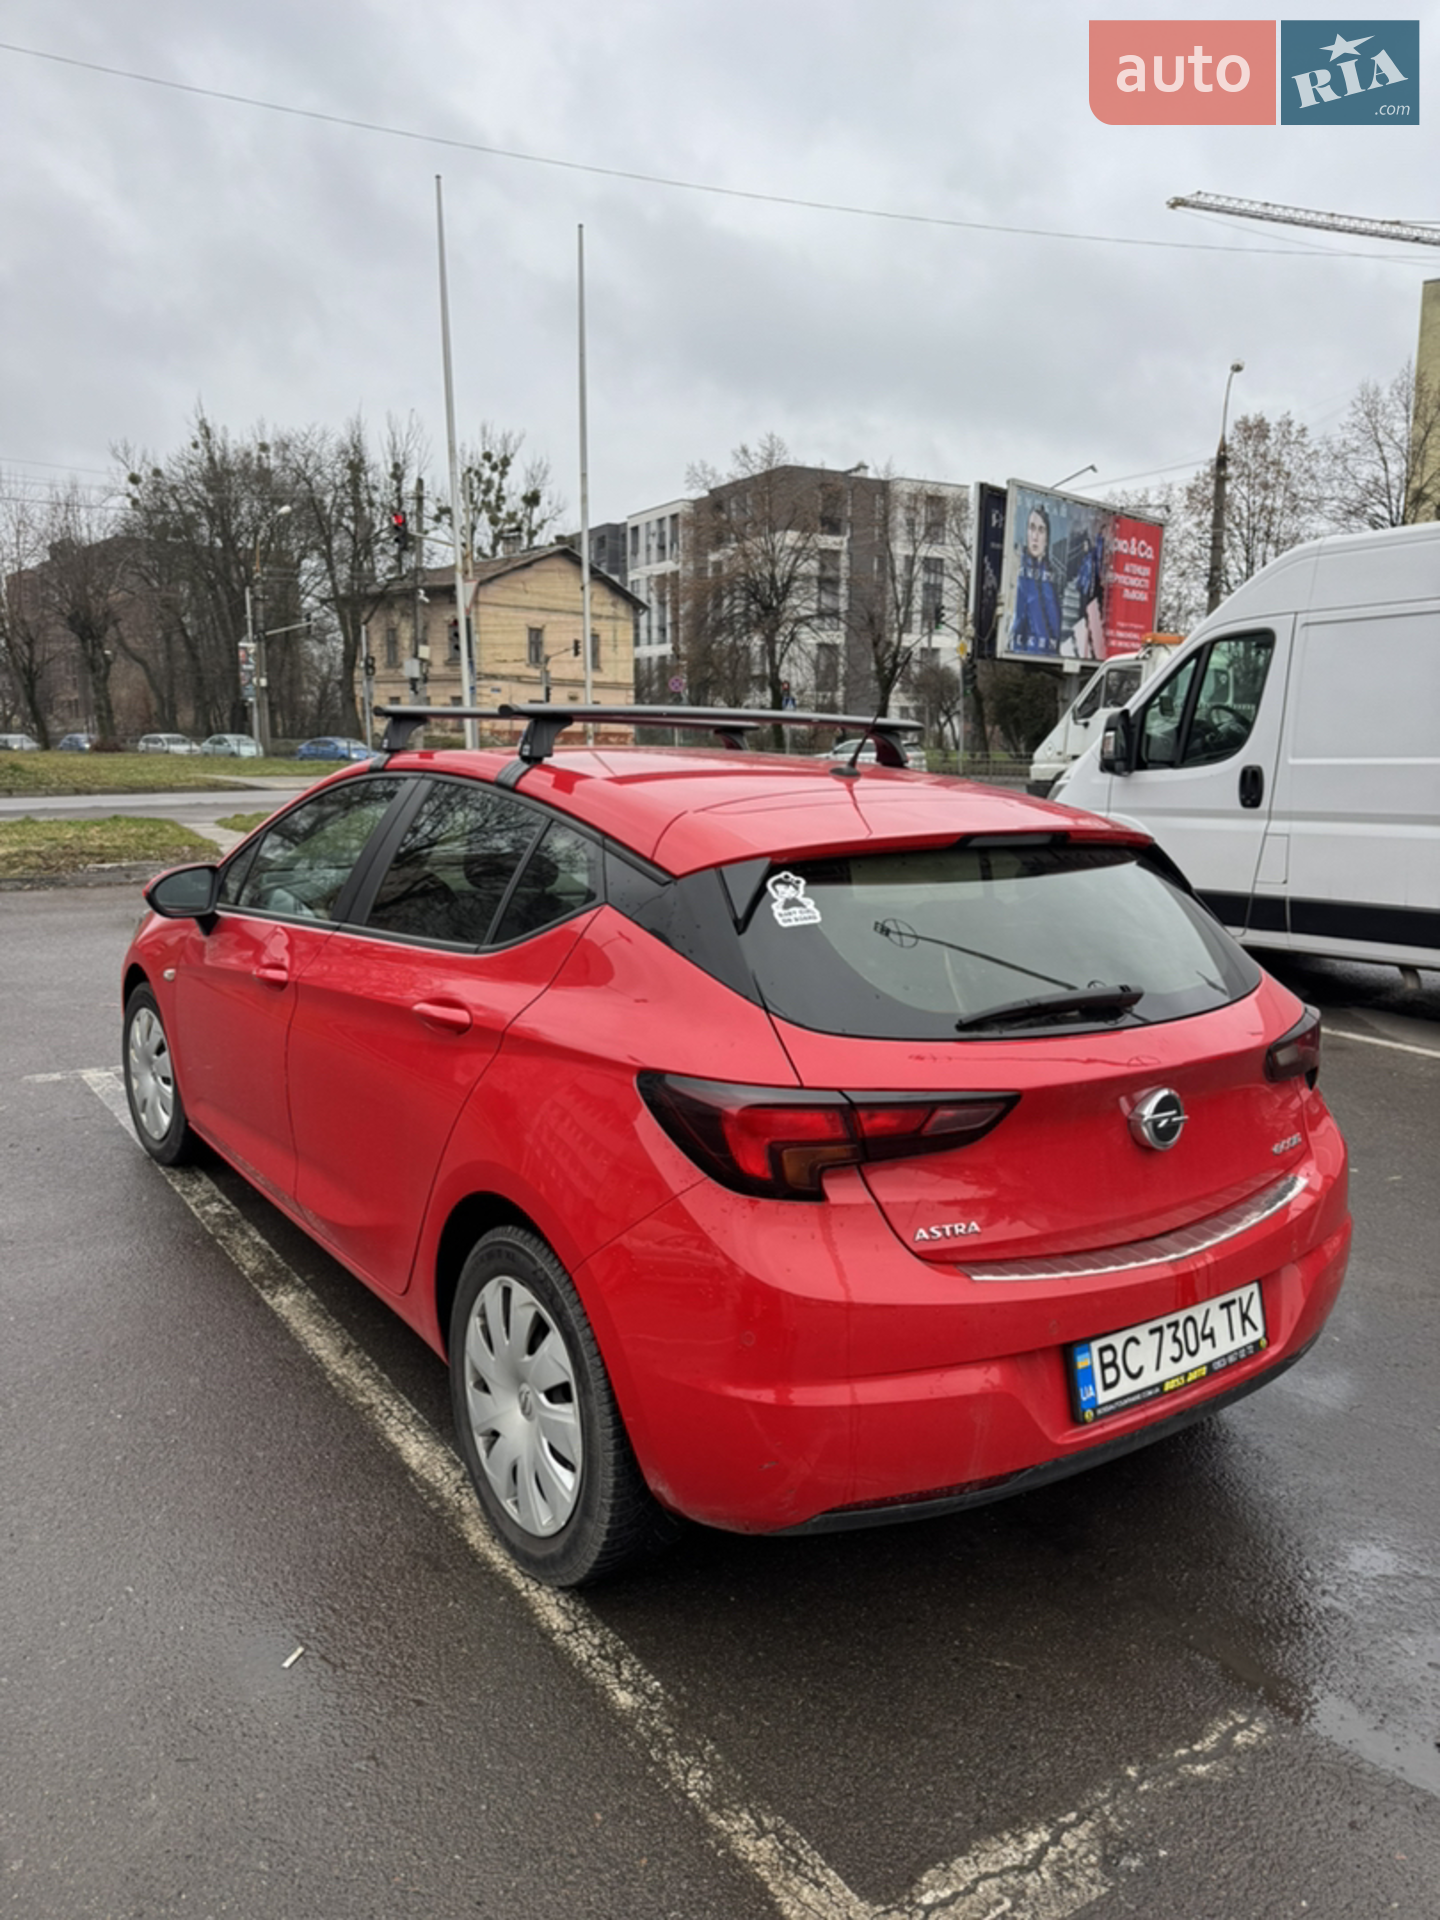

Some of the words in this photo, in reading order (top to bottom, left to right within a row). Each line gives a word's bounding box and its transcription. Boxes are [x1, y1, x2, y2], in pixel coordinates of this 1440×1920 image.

[914, 1221, 981, 1242] ASTRA
[1098, 1335, 1144, 1391] BC
[1148, 1308, 1216, 1372] 7304
[1219, 1291, 1258, 1342] TK
[1080, 1384, 1095, 1401] UA
